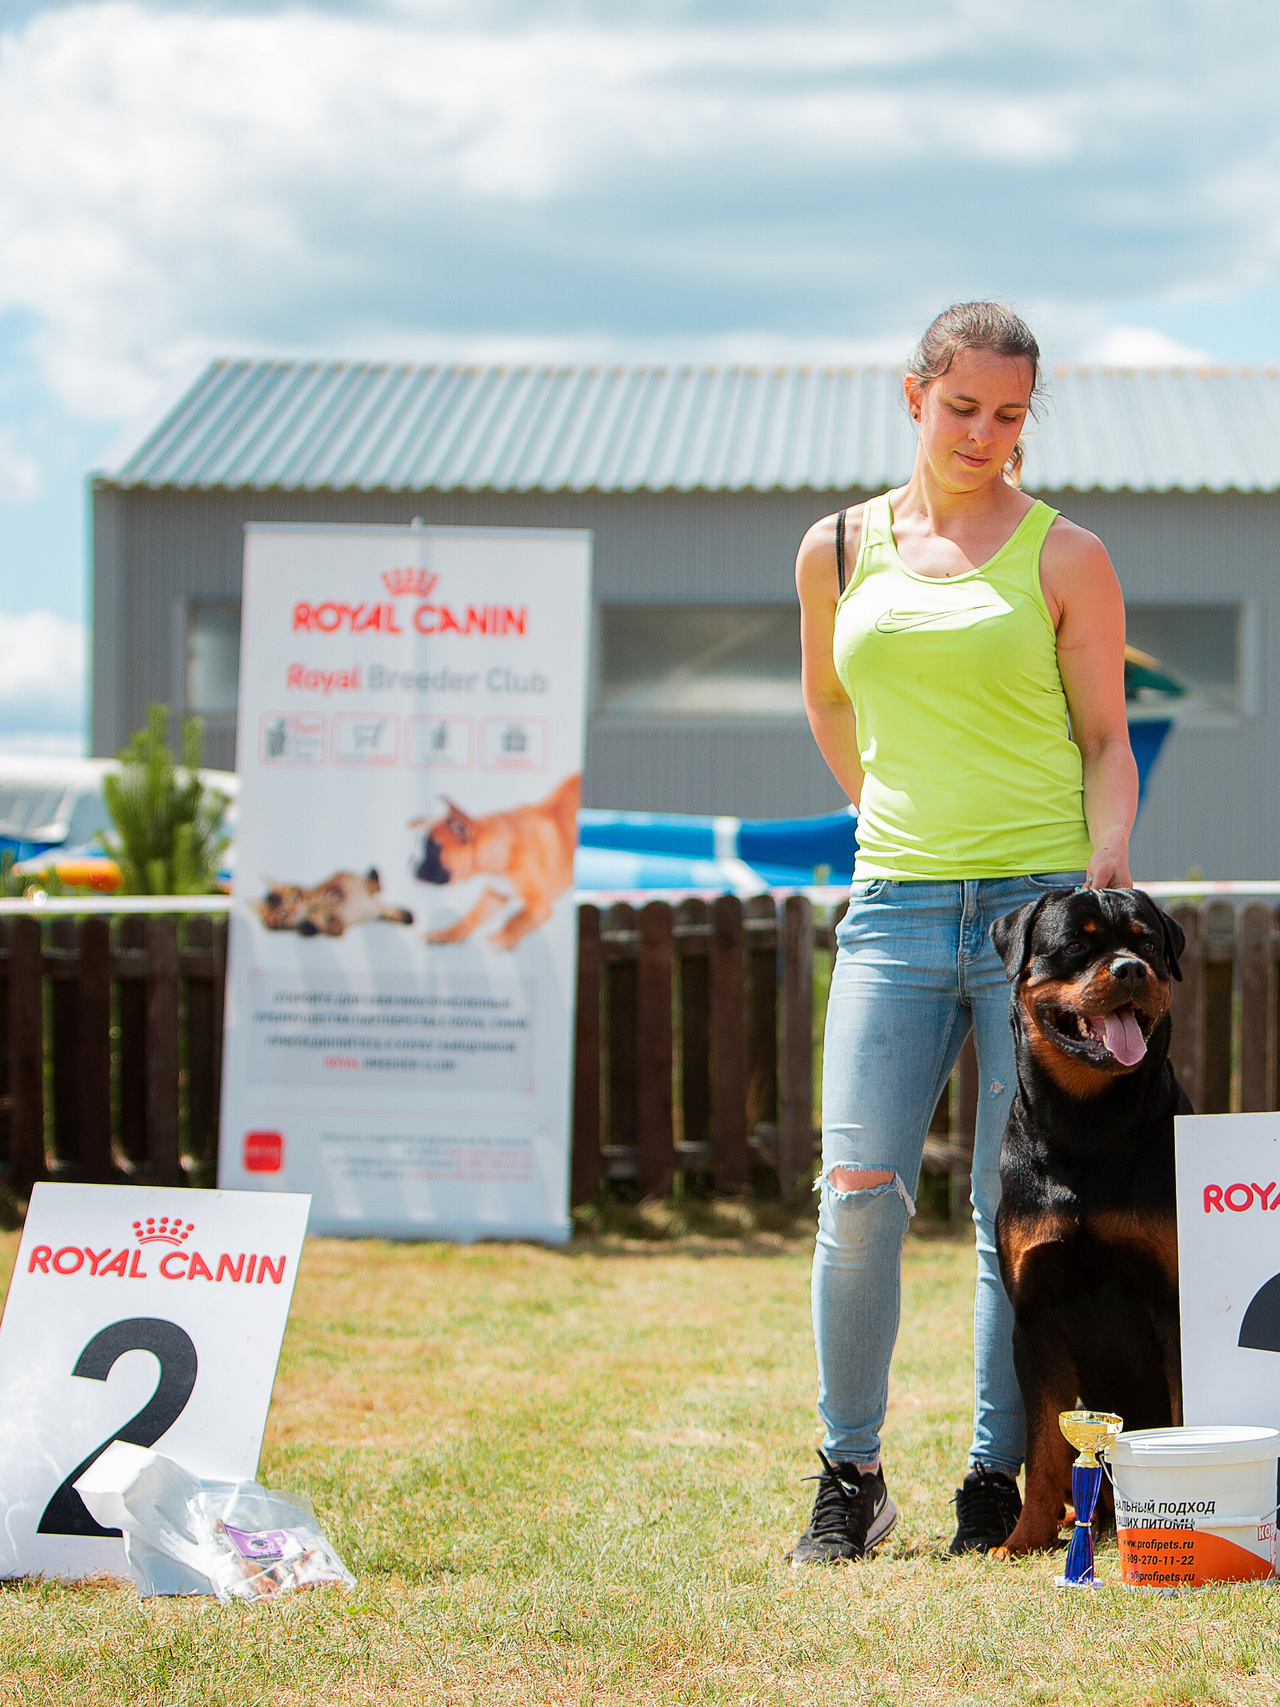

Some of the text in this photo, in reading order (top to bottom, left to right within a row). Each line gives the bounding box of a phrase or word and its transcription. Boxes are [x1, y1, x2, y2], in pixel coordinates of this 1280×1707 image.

[294, 604, 526, 635] ROYAL CANIN
[287, 664, 547, 694] Royal Breeder Club
[28, 1245, 287, 1284] ROYAL CANIN
[37, 1317, 198, 1538] 2
[1158, 1501, 1216, 1516] ПОДХОД
